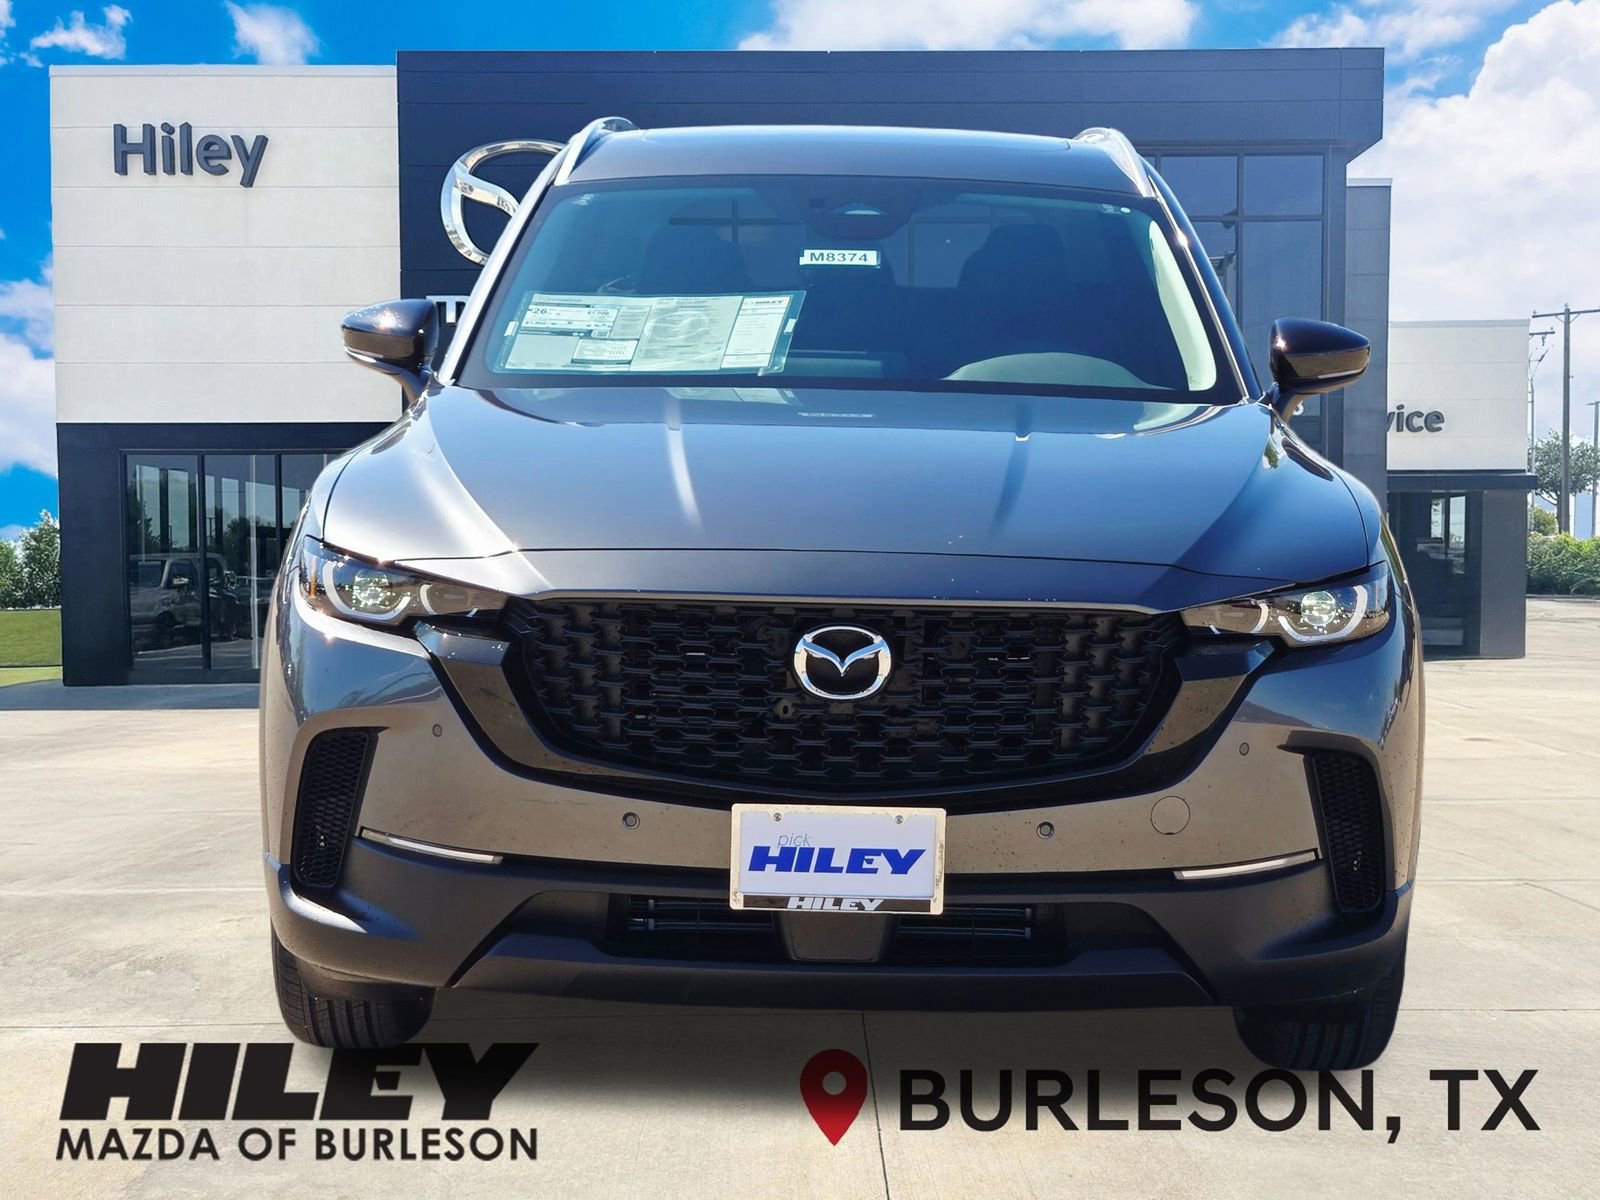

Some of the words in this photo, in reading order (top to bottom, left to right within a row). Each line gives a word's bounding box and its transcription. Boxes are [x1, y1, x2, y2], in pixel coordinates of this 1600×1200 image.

[113, 122, 268, 188] Hiley
[809, 252, 868, 262] M8374
[776, 833, 812, 849] pick
[748, 845, 926, 875] HILEY
[787, 896, 884, 911] HILEY
